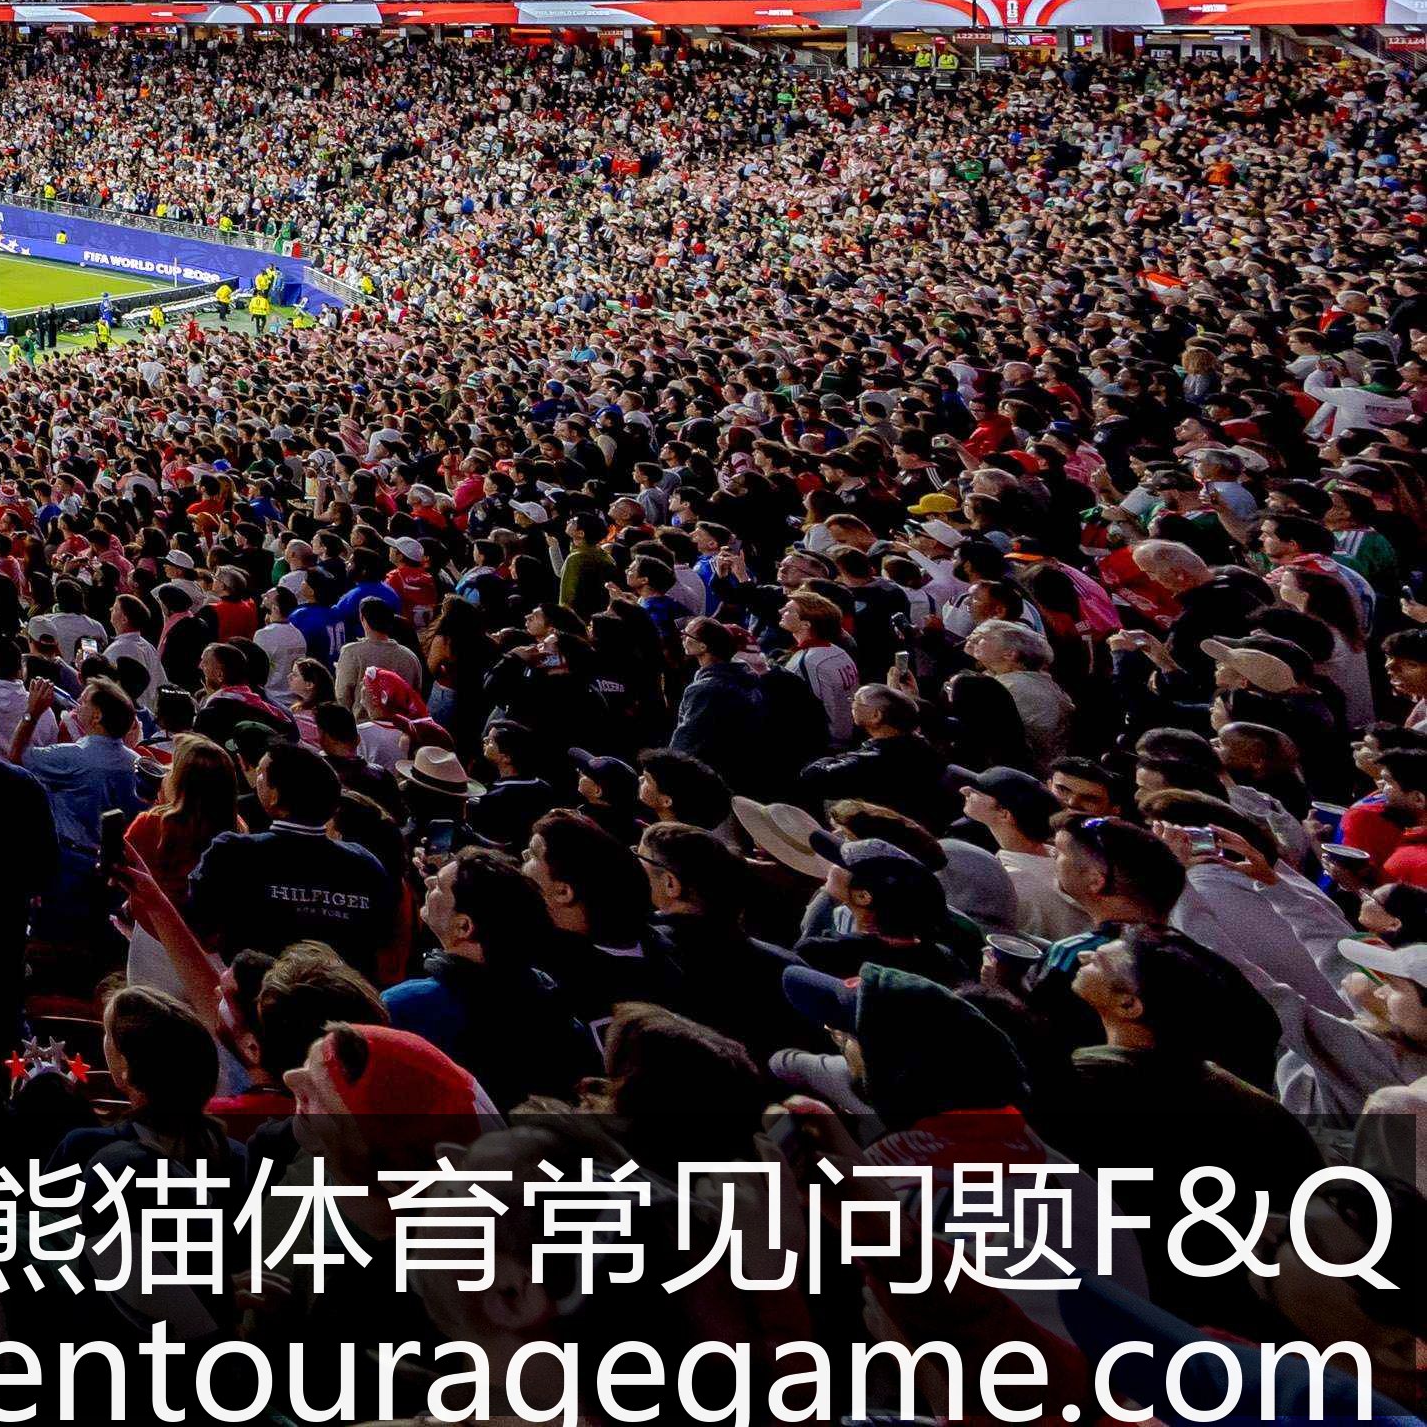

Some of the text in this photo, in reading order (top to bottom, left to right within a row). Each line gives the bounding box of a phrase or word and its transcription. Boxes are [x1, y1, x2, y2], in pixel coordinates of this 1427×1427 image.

[83, 251, 220, 283] FIFA WORLD CUP 2026
[270, 886, 370, 909] HILFIGER
